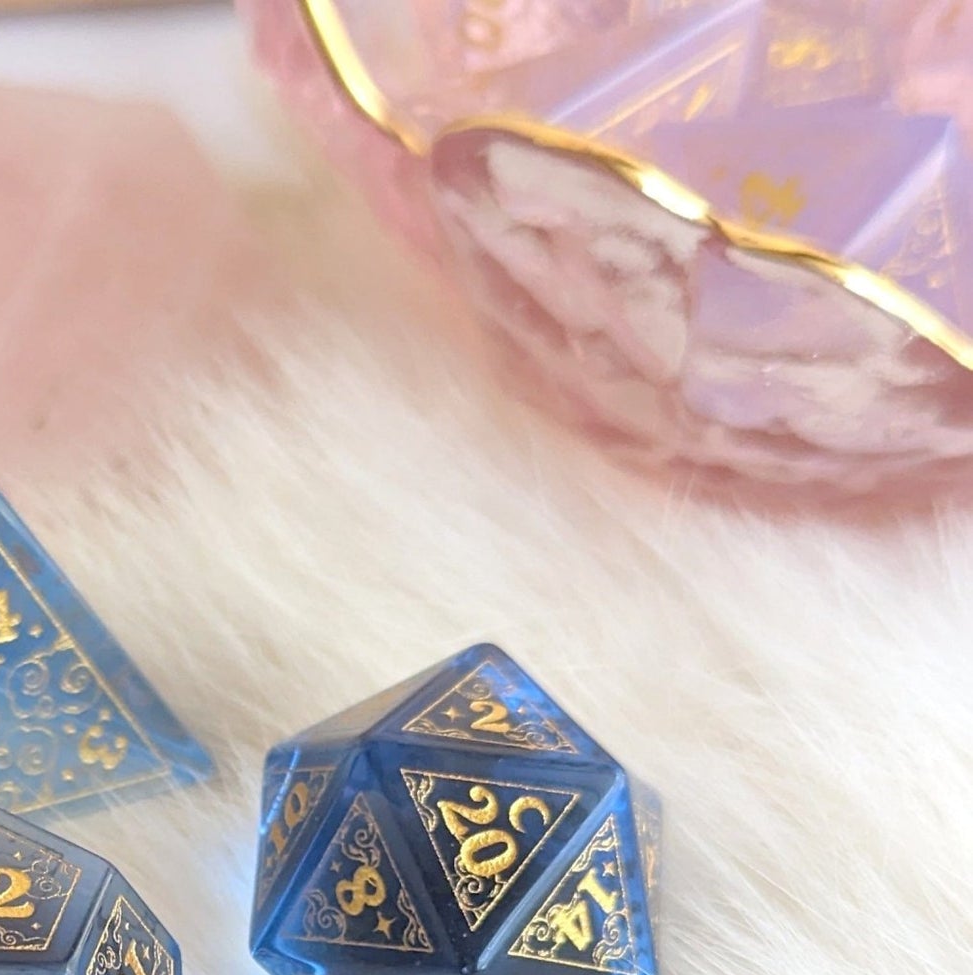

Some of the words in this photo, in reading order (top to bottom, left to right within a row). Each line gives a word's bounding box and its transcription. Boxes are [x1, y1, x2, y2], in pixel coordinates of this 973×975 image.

[78, 725, 127, 770] 3
[470, 700, 511, 734] 2
[270, 781, 310, 858] 10
[437, 786, 520, 878] 20
[335, 865, 388, 917] 8
[549, 869, 620, 953] 14
